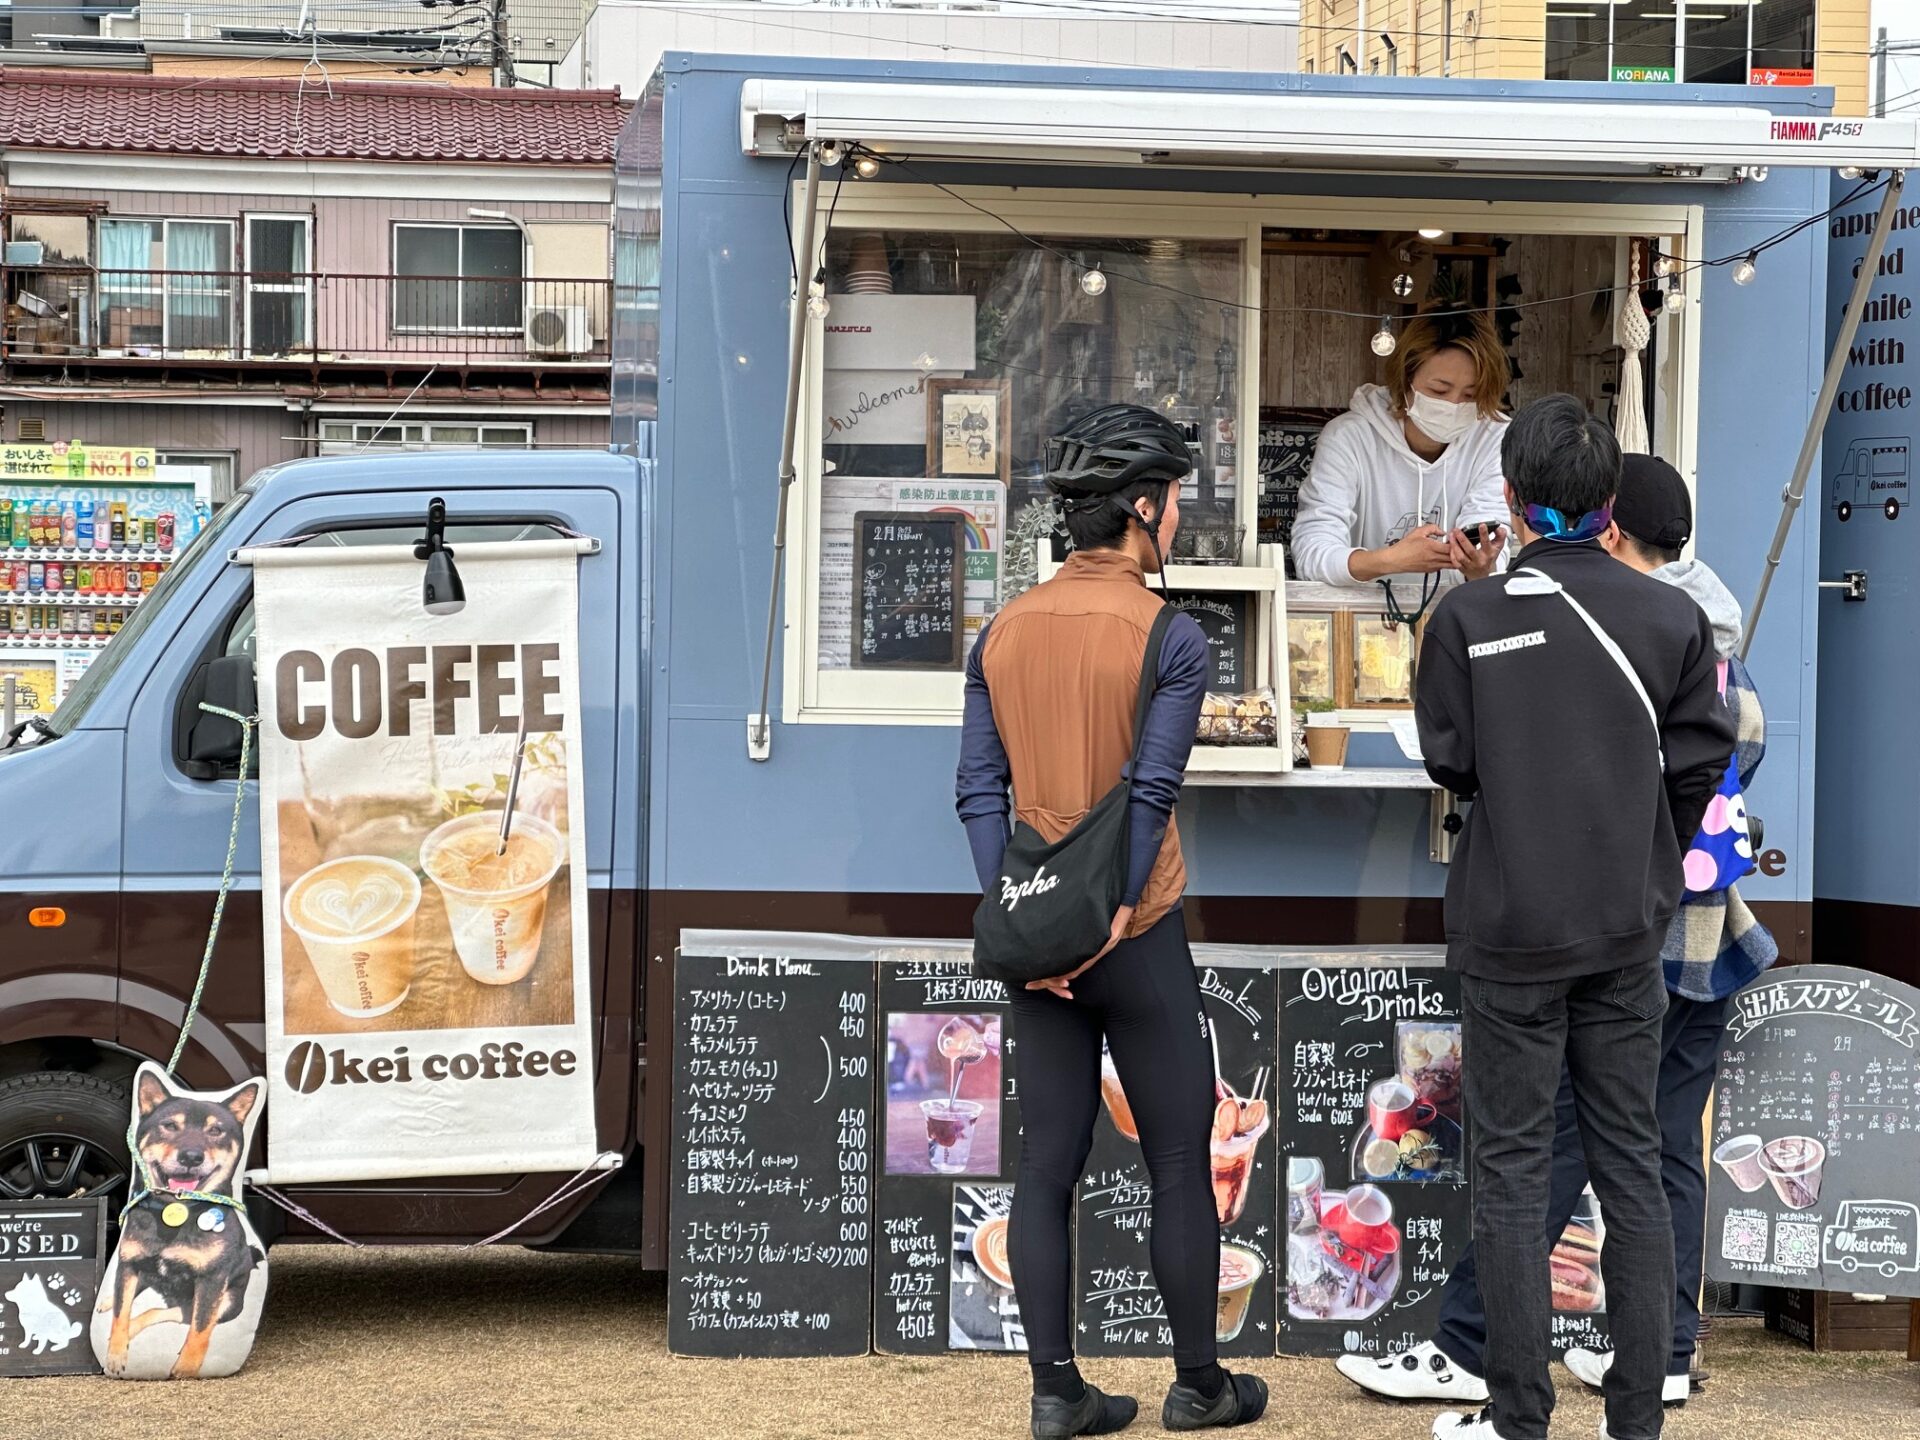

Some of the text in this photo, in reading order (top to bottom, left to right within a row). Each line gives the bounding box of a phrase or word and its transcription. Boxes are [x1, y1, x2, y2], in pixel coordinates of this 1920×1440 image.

[1616, 70, 1670, 82] KORIANA
[1770, 121, 1817, 141] FIAMMA
[1849, 338, 1904, 368] with
[1838, 383, 1912, 413] coffee
[5, 449, 52, 460] おいしさで
[91, 451, 132, 477] No.1
[900, 488, 997, 501] 感染防止徹底宣言
[873, 526, 894, 541] 2月
[275, 643, 565, 741] COFFEE
[727, 954, 812, 976] Drink Menu
[1199, 968, 1253, 1009] Drink
[1302, 963, 1409, 1006] Original
[839, 991, 866, 1014] 400
[1361, 983, 1444, 1022] Drinks
[1744, 979, 1901, 1025] 出店スケジュール
[690, 1014, 865, 1038] カフェラテ 450
[690, 1034, 758, 1054] キャラメルラテ
[1294, 1040, 1336, 1068] 自家製
[1834, 1036, 1852, 1052] 2月
[329, 1041, 577, 1084] kei coffee
[840, 1056, 867, 1078] 500
[689, 1082, 776, 1103] ヘーゼルナッツラテ
[688, 1102, 865, 1128] チョコミルク 450
[1298, 1109, 1322, 1123] Soda
[686, 1126, 866, 1150] ルイボスティ 400
[687, 1148, 754, 1170] 自家製チャイ
[839, 1152, 867, 1172] 600
[687, 1172, 867, 1196] 自家製ジンジャーレモネード 550
[1110, 1186, 1152, 1205] ショコララ
[803, 1194, 839, 1212] ソーダ
[840, 1196, 867, 1214] 600
[0, 1220, 42, 1233] we're
[687, 1221, 867, 1244] コーヒーゼリーラテ 600
[1406, 1216, 1442, 1242] 自家製
[1418, 1242, 1443, 1264] チャイ
[1850, 1232, 1908, 1255] kei coffee
[843, 1247, 867, 1267] 200
[890, 1272, 936, 1293] カフェラテ
[1090, 1266, 1149, 1291] マカダミア
[1413, 1266, 1450, 1286] Hot only
[1104, 1295, 1164, 1318] チョコミルク
[804, 1314, 830, 1330] +100
[896, 1315, 925, 1340] 450
[1360, 1332, 1380, 1352] kei
